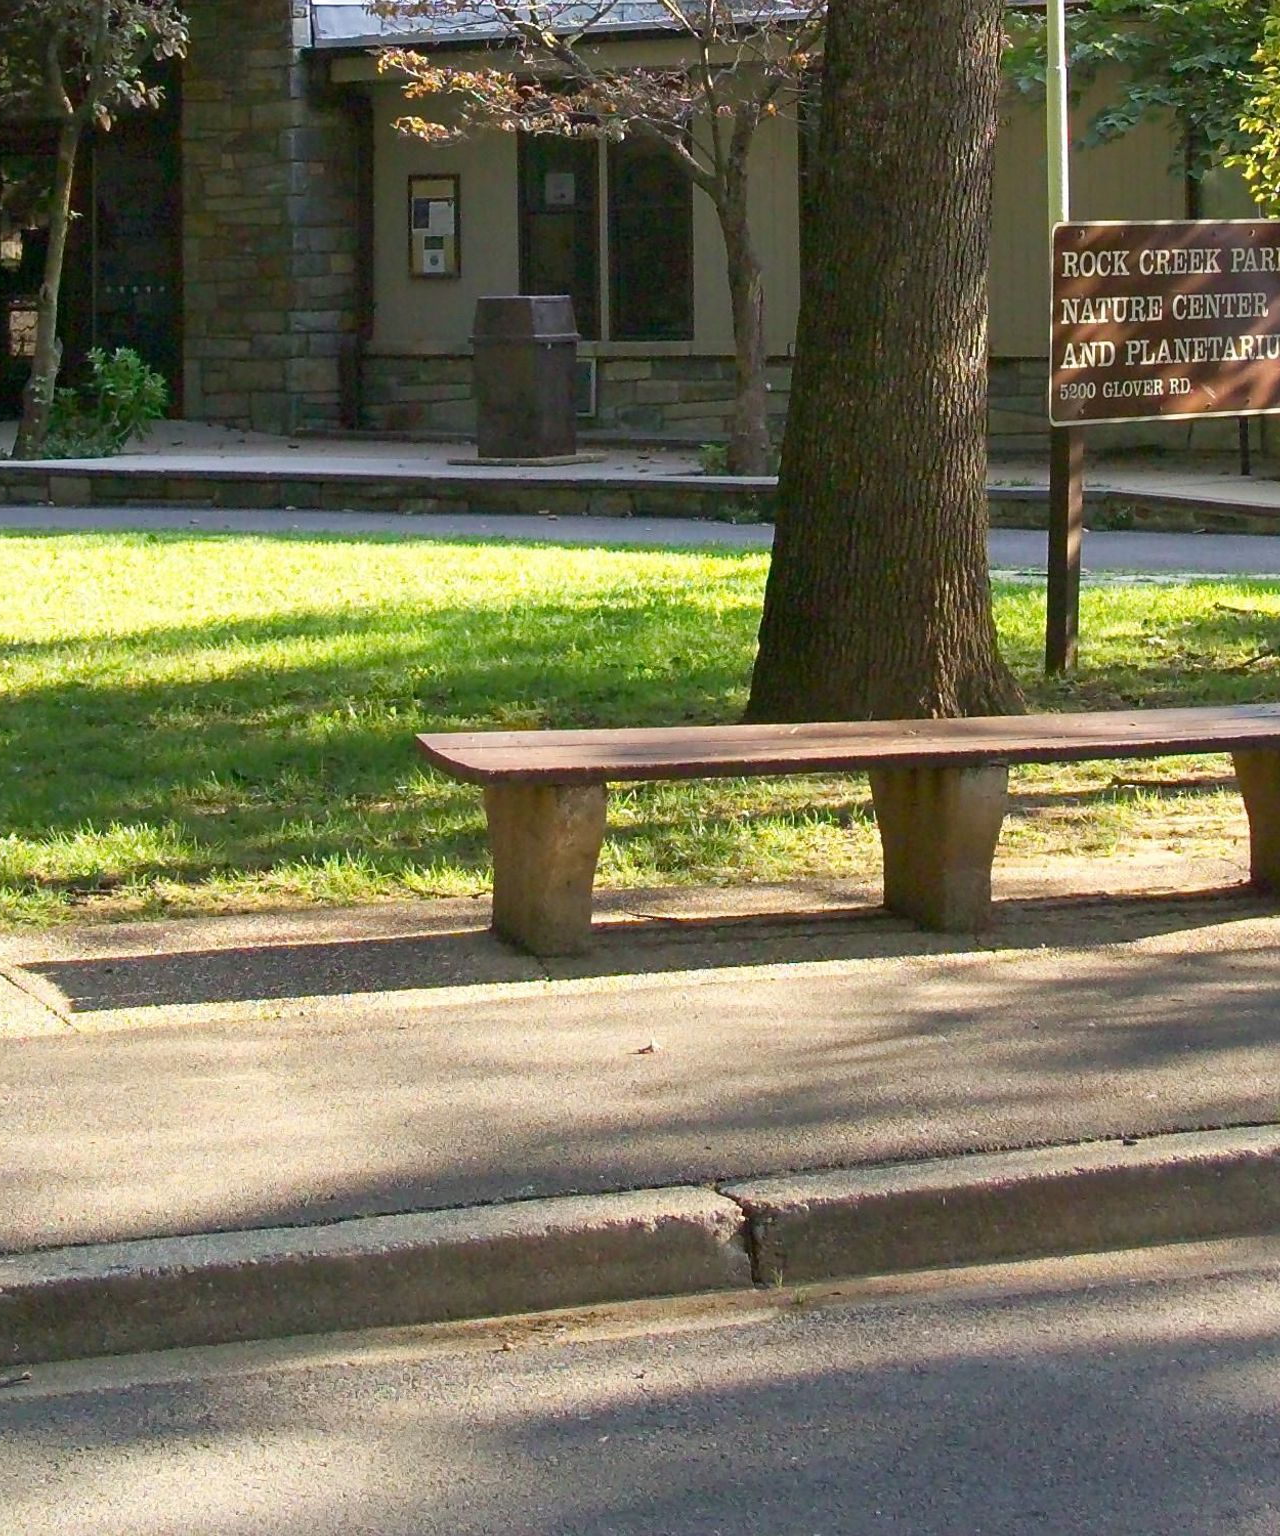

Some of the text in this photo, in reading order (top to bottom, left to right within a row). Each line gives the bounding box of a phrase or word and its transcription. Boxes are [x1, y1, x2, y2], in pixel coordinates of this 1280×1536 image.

[1061, 251, 1129, 277] ROCK
[1139, 249, 1222, 275] CREEK
[1061, 293, 1268, 324] NATURE CENTER
[1060, 341, 1115, 369] AND
[1060, 382, 1096, 400] 5200
[1103, 379, 1163, 398] GLOVER
